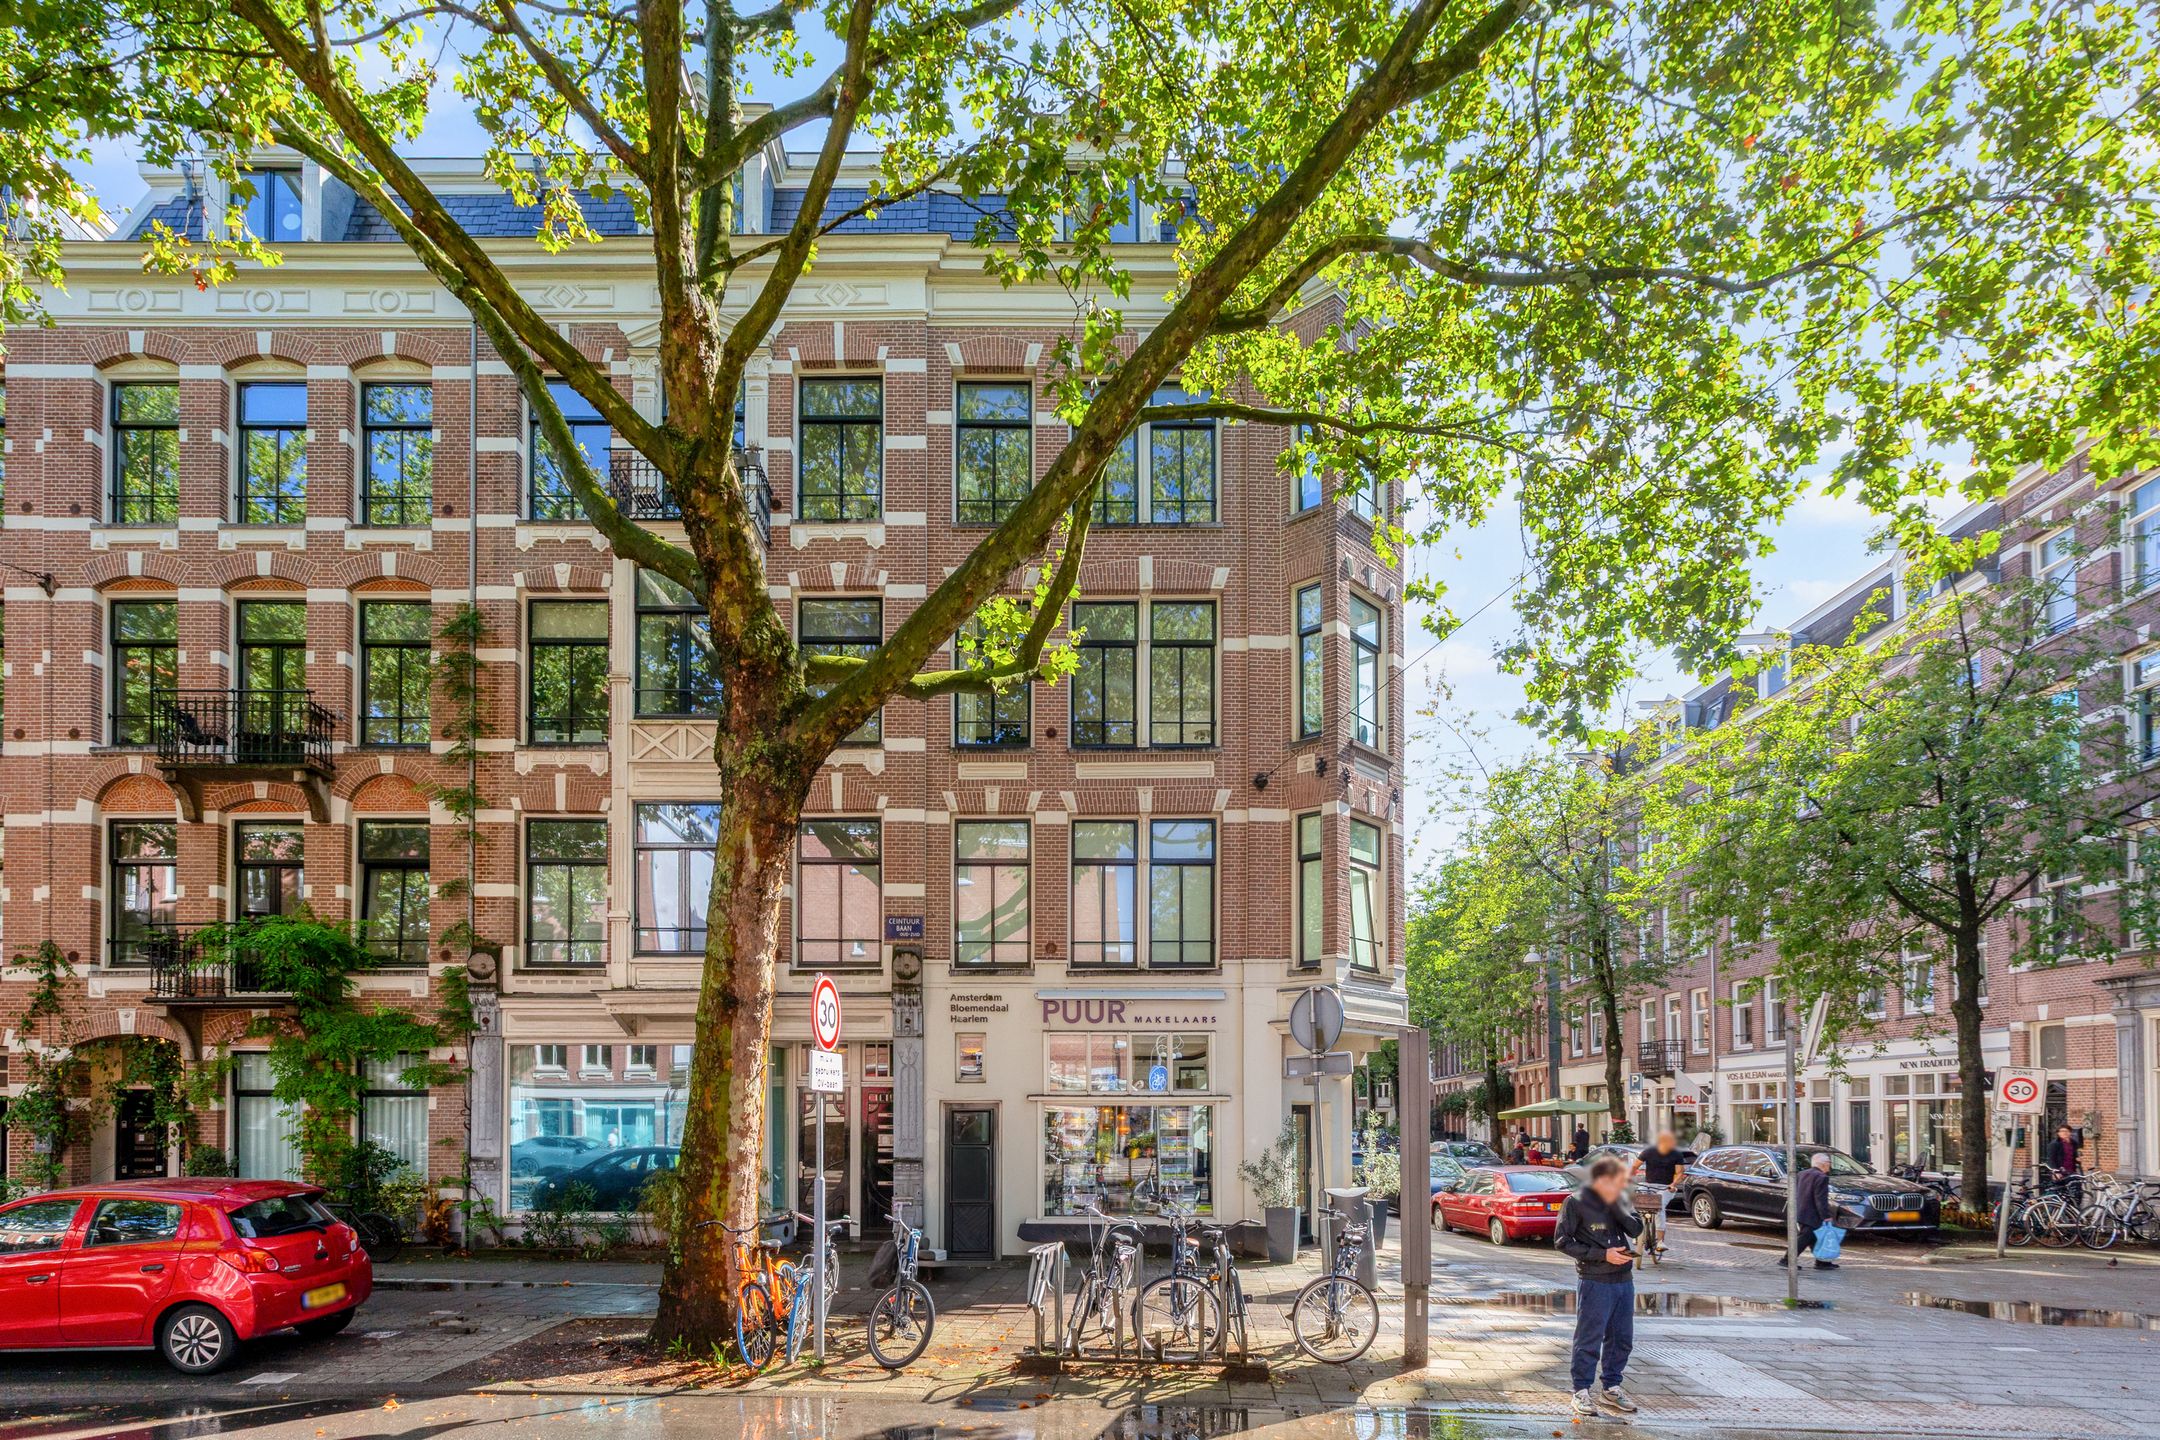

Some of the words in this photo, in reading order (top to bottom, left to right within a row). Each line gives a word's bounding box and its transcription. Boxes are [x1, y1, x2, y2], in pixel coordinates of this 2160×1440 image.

[888, 917, 920, 925] CEINTUUR
[950, 993, 1002, 1001] Amsterdam
[950, 1004, 1009, 1012] Bloemendaal
[1042, 1000, 1126, 1024] PUUR
[819, 1000, 836, 1029] 30
[950, 1015, 988, 1023] Haarlem
[1900, 1061, 1918, 1069] NEW
[1631, 1075, 1639, 1086] P
[2010, 1085, 2032, 1095] 30
[1676, 1095, 1696, 1104] SOL
